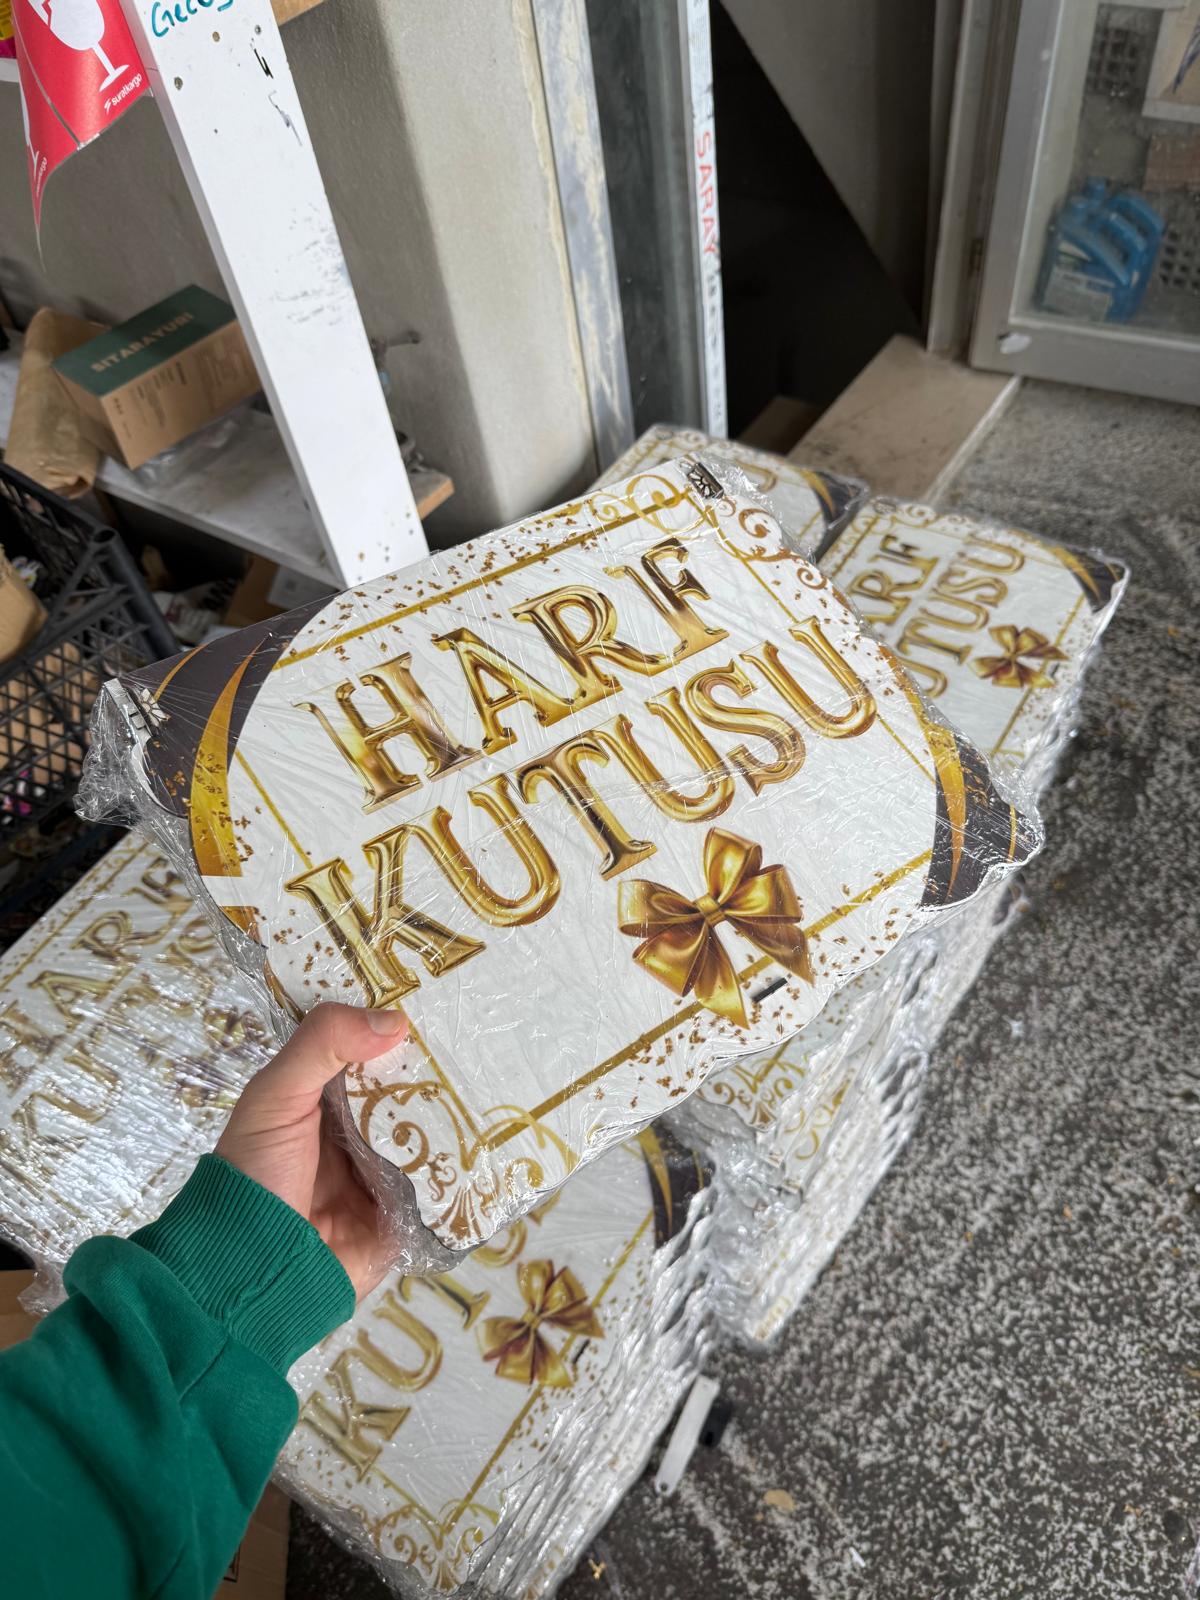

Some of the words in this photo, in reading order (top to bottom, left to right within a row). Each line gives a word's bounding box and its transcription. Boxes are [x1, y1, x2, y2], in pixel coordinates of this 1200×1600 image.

[696, 131, 719, 254] SARAY
[284, 616, 877, 1009] KUTUSU
[292, 537, 730, 815] HARF
